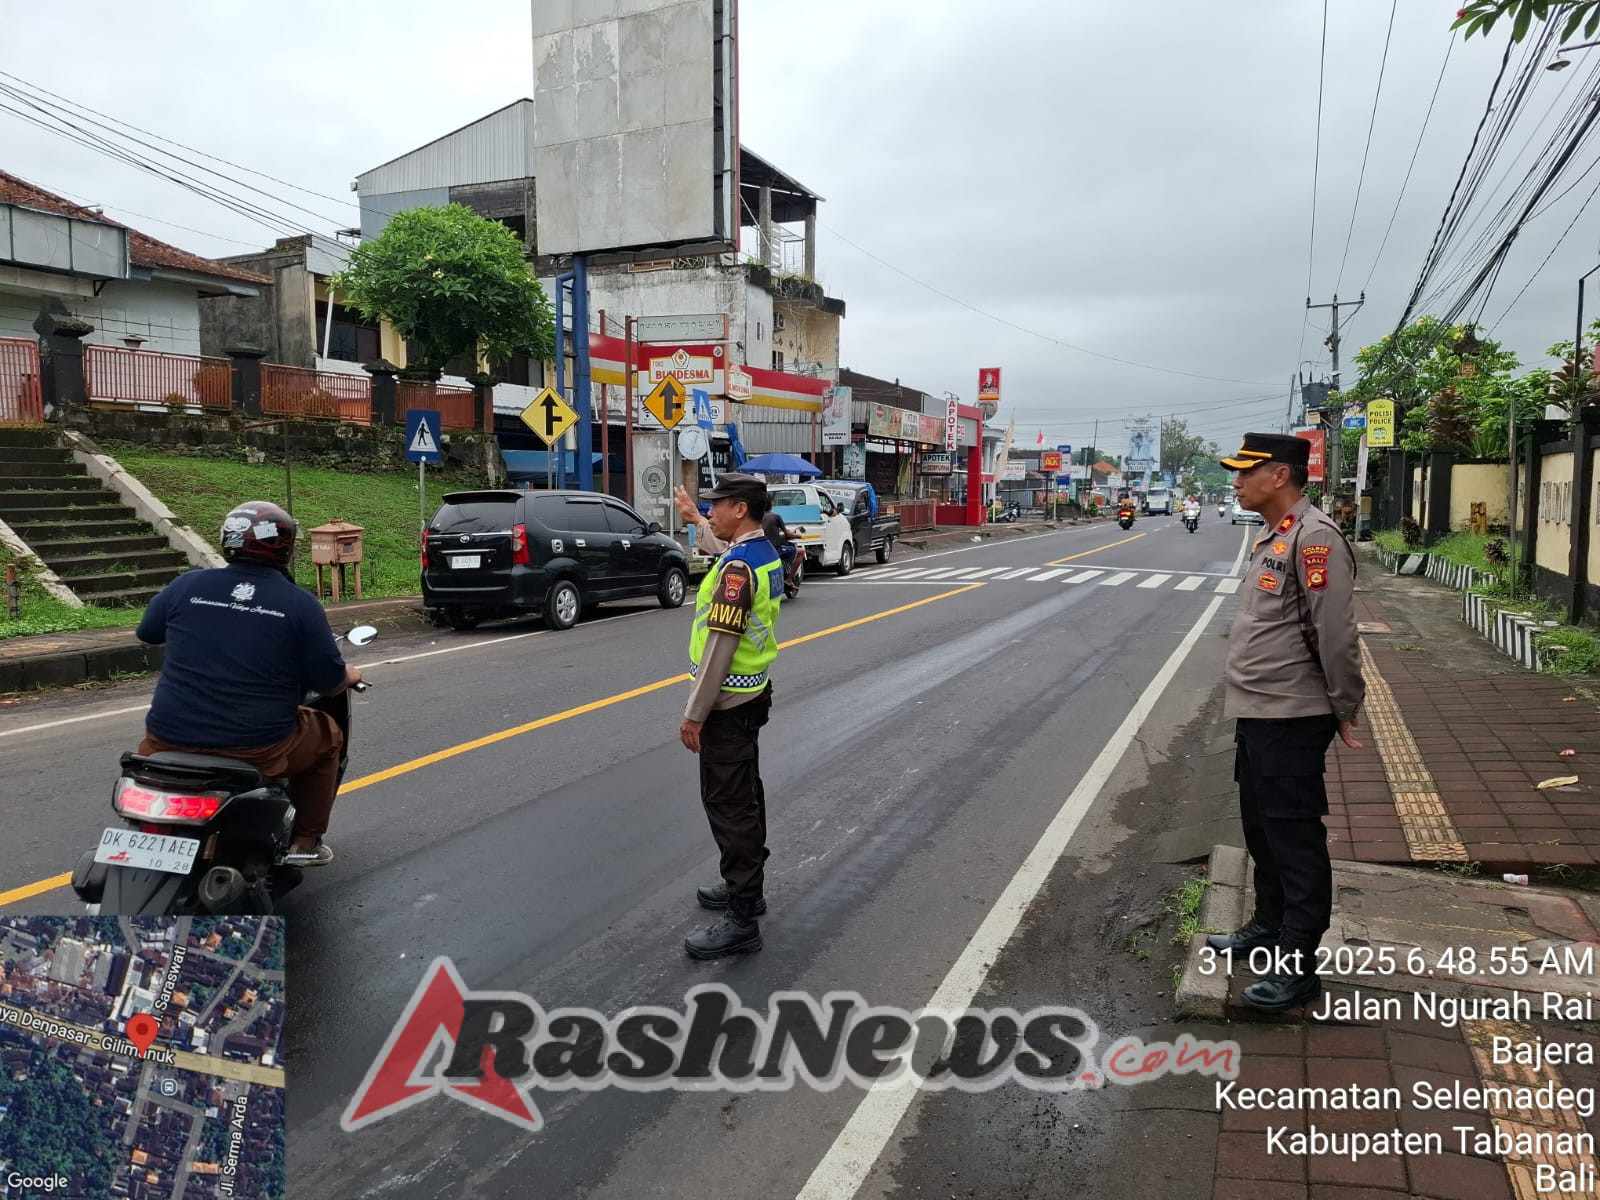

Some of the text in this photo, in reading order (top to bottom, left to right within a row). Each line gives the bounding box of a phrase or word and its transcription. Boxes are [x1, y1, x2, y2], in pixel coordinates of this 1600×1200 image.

[1369, 410, 1392, 418] POLISI
[946, 400, 956, 450] APOTEK
[923, 454, 951, 462] APOTEK
[1262, 557, 1287, 573] POLRI
[102, 830, 198, 857] DK 6221 AEE
